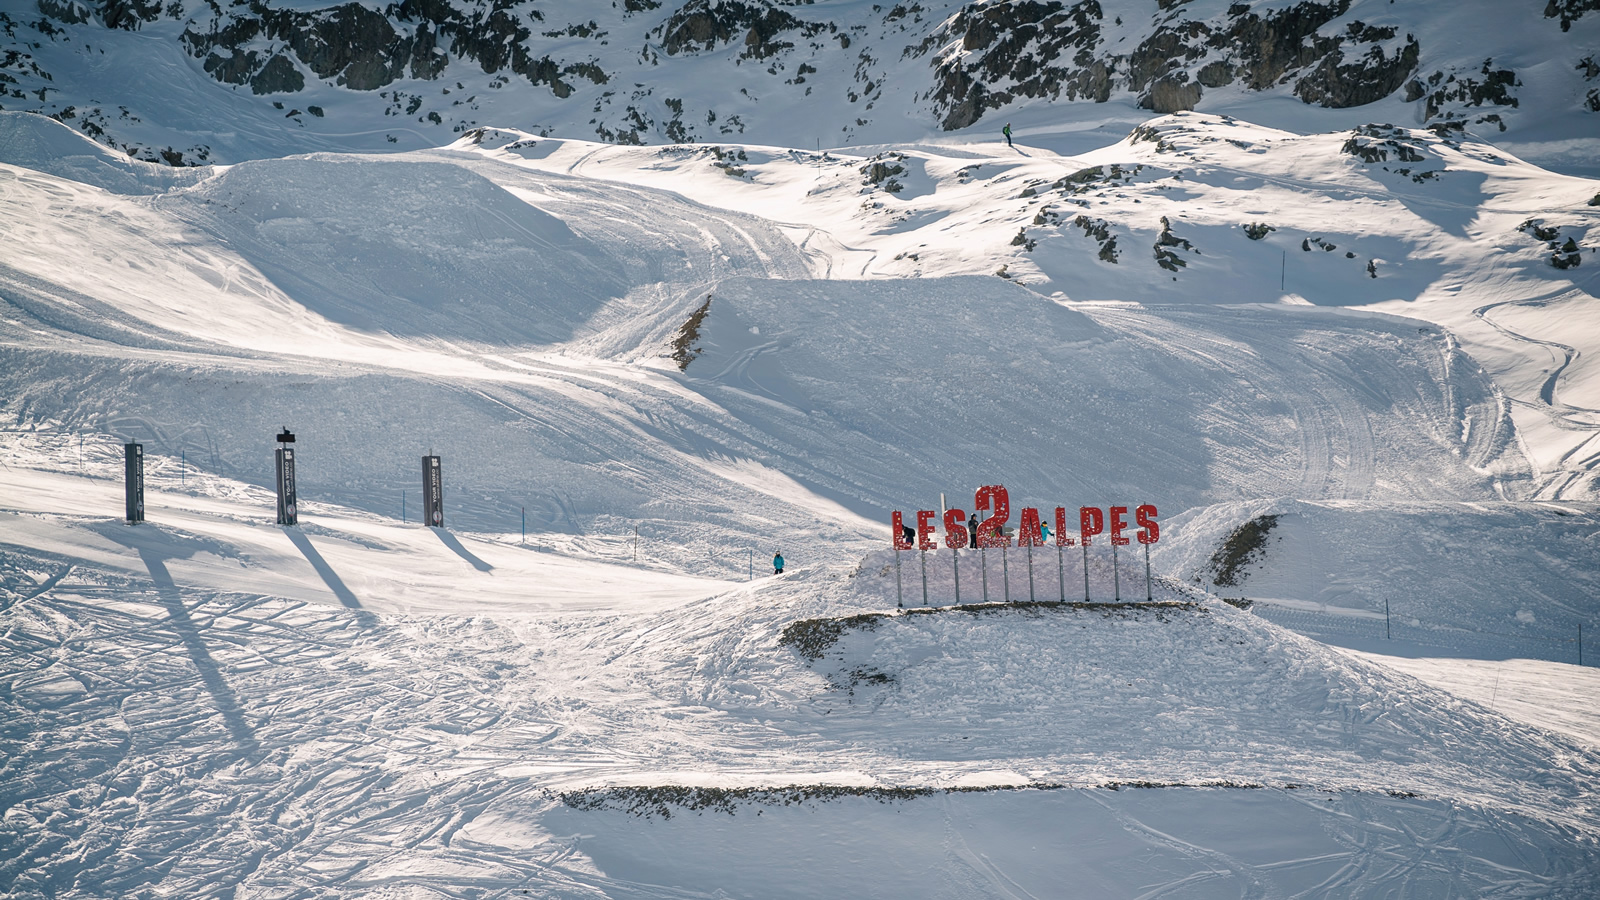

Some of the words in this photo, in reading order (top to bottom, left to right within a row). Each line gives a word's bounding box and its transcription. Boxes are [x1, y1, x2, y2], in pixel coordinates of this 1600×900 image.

[891, 508, 968, 551] LES
[974, 484, 1012, 548] 2
[1018, 505, 1160, 548] ALPES
